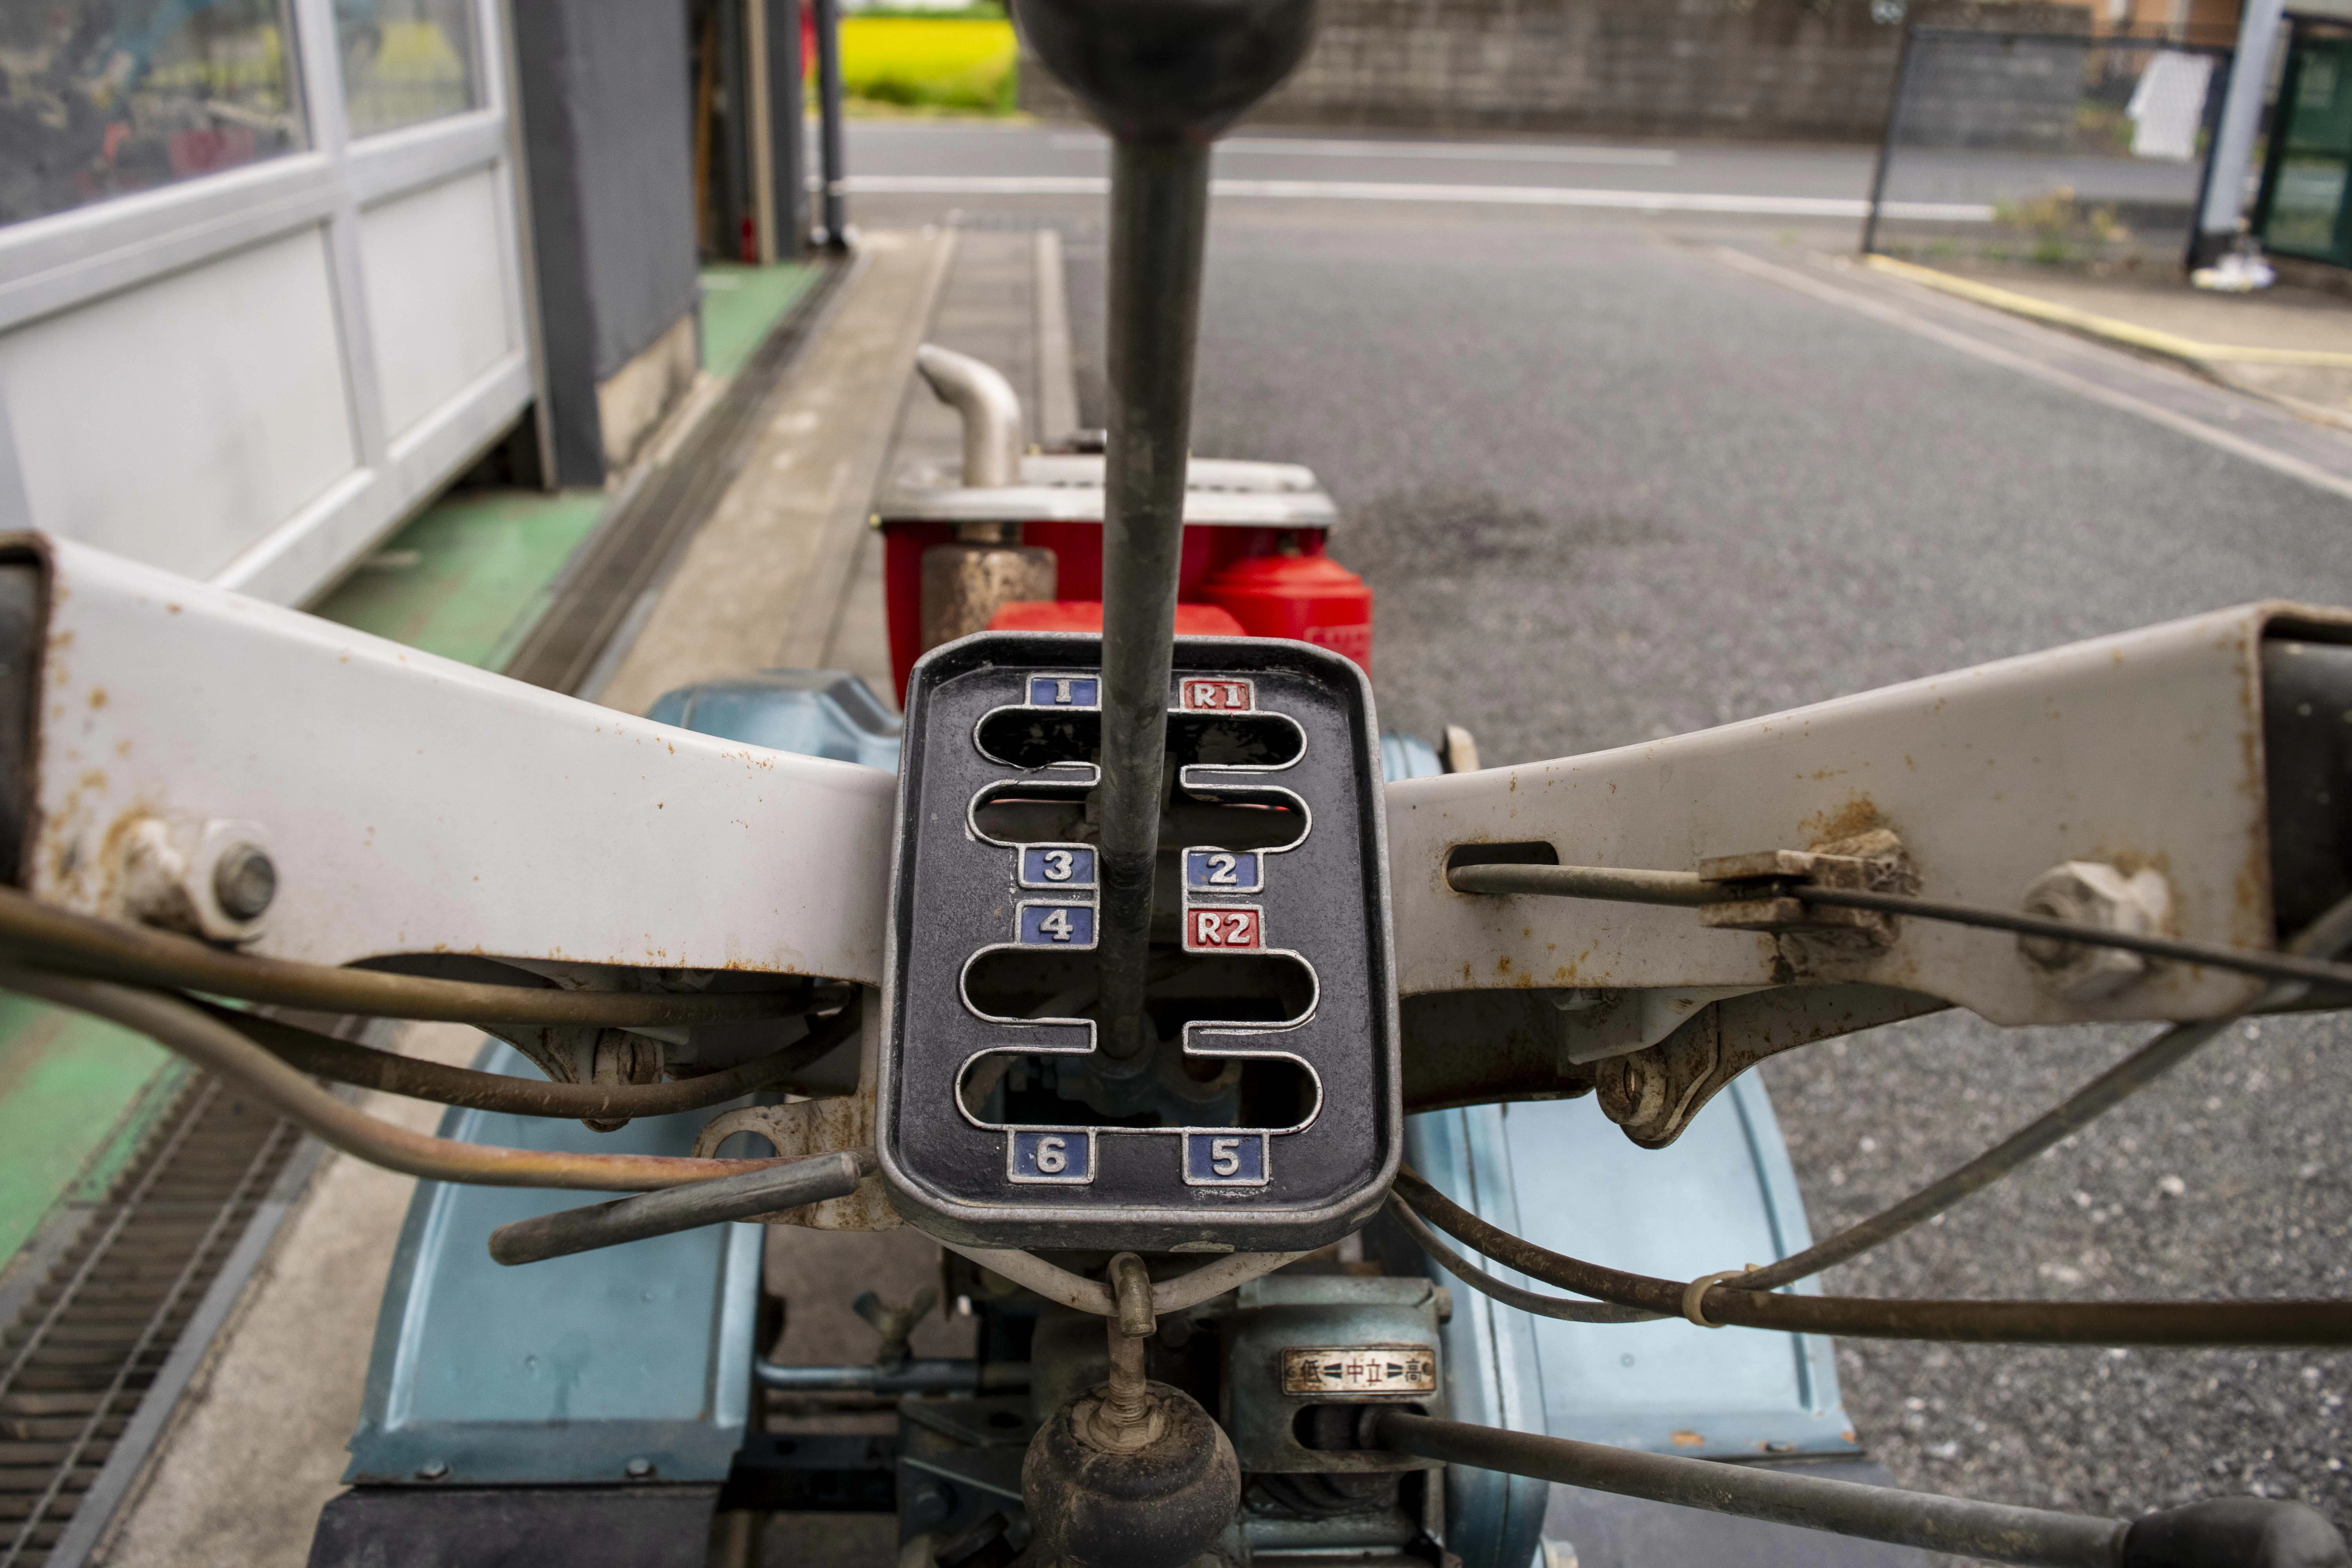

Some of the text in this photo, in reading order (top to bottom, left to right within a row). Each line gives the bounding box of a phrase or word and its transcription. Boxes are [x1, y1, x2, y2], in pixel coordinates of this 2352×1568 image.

[1055, 678, 1072, 704] 1
[1193, 684, 1242, 709] R1
[1043, 850, 1074, 882] 3
[1207, 855, 1239, 885] 2
[1040, 909, 1074, 941] 4
[1197, 912, 1252, 945] R2
[1036, 1137, 1068, 1174] 6
[1211, 1138, 1240, 1176] 5
[1301, 1358, 1422, 1383] 低 中立 高
